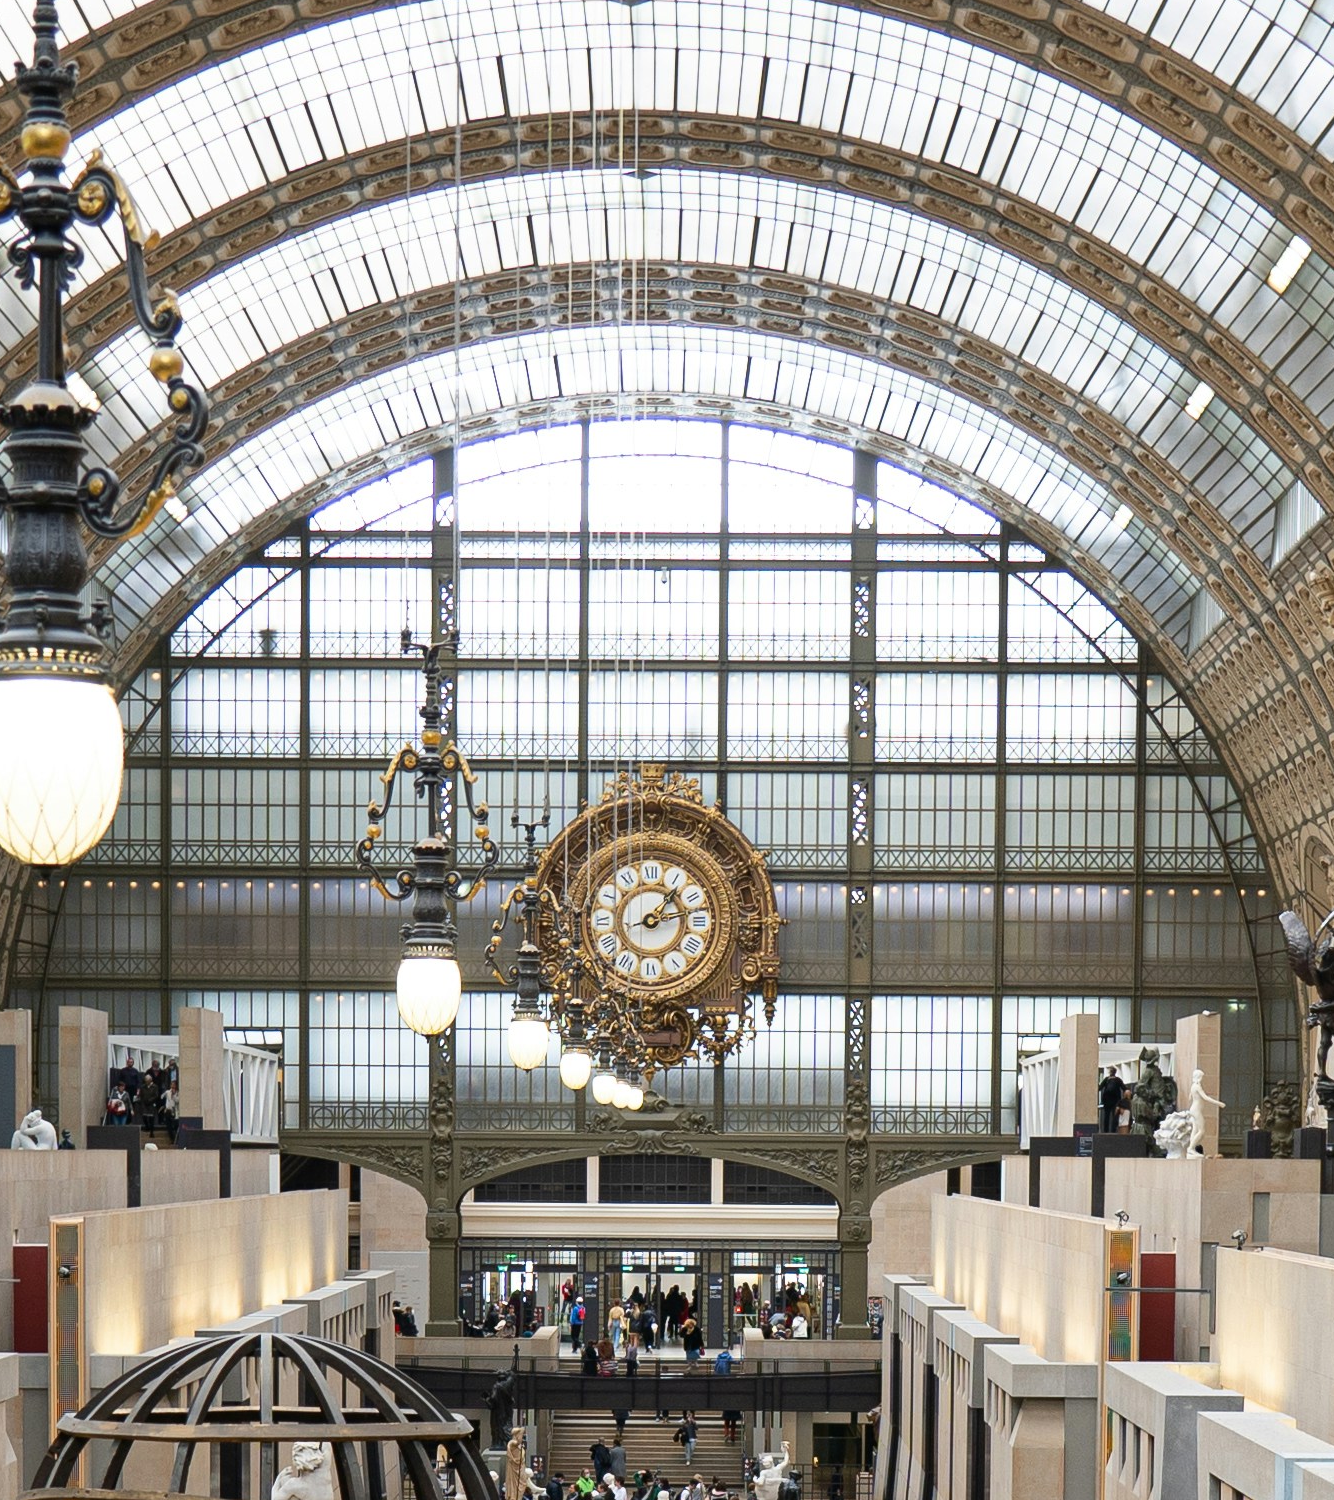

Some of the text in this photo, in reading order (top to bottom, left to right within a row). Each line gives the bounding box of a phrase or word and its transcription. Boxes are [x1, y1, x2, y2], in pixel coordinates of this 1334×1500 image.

[621, 871, 634, 886] XI
[644, 866, 657, 879] XII
[672, 873, 679, 885] I
[687, 892, 699, 902] II
[597, 916, 609, 926] IX
[693, 916, 705, 926] III
[684, 937, 701, 954] IIII
[619, 955, 634, 971] VII
[646, 963, 656, 975] VI
